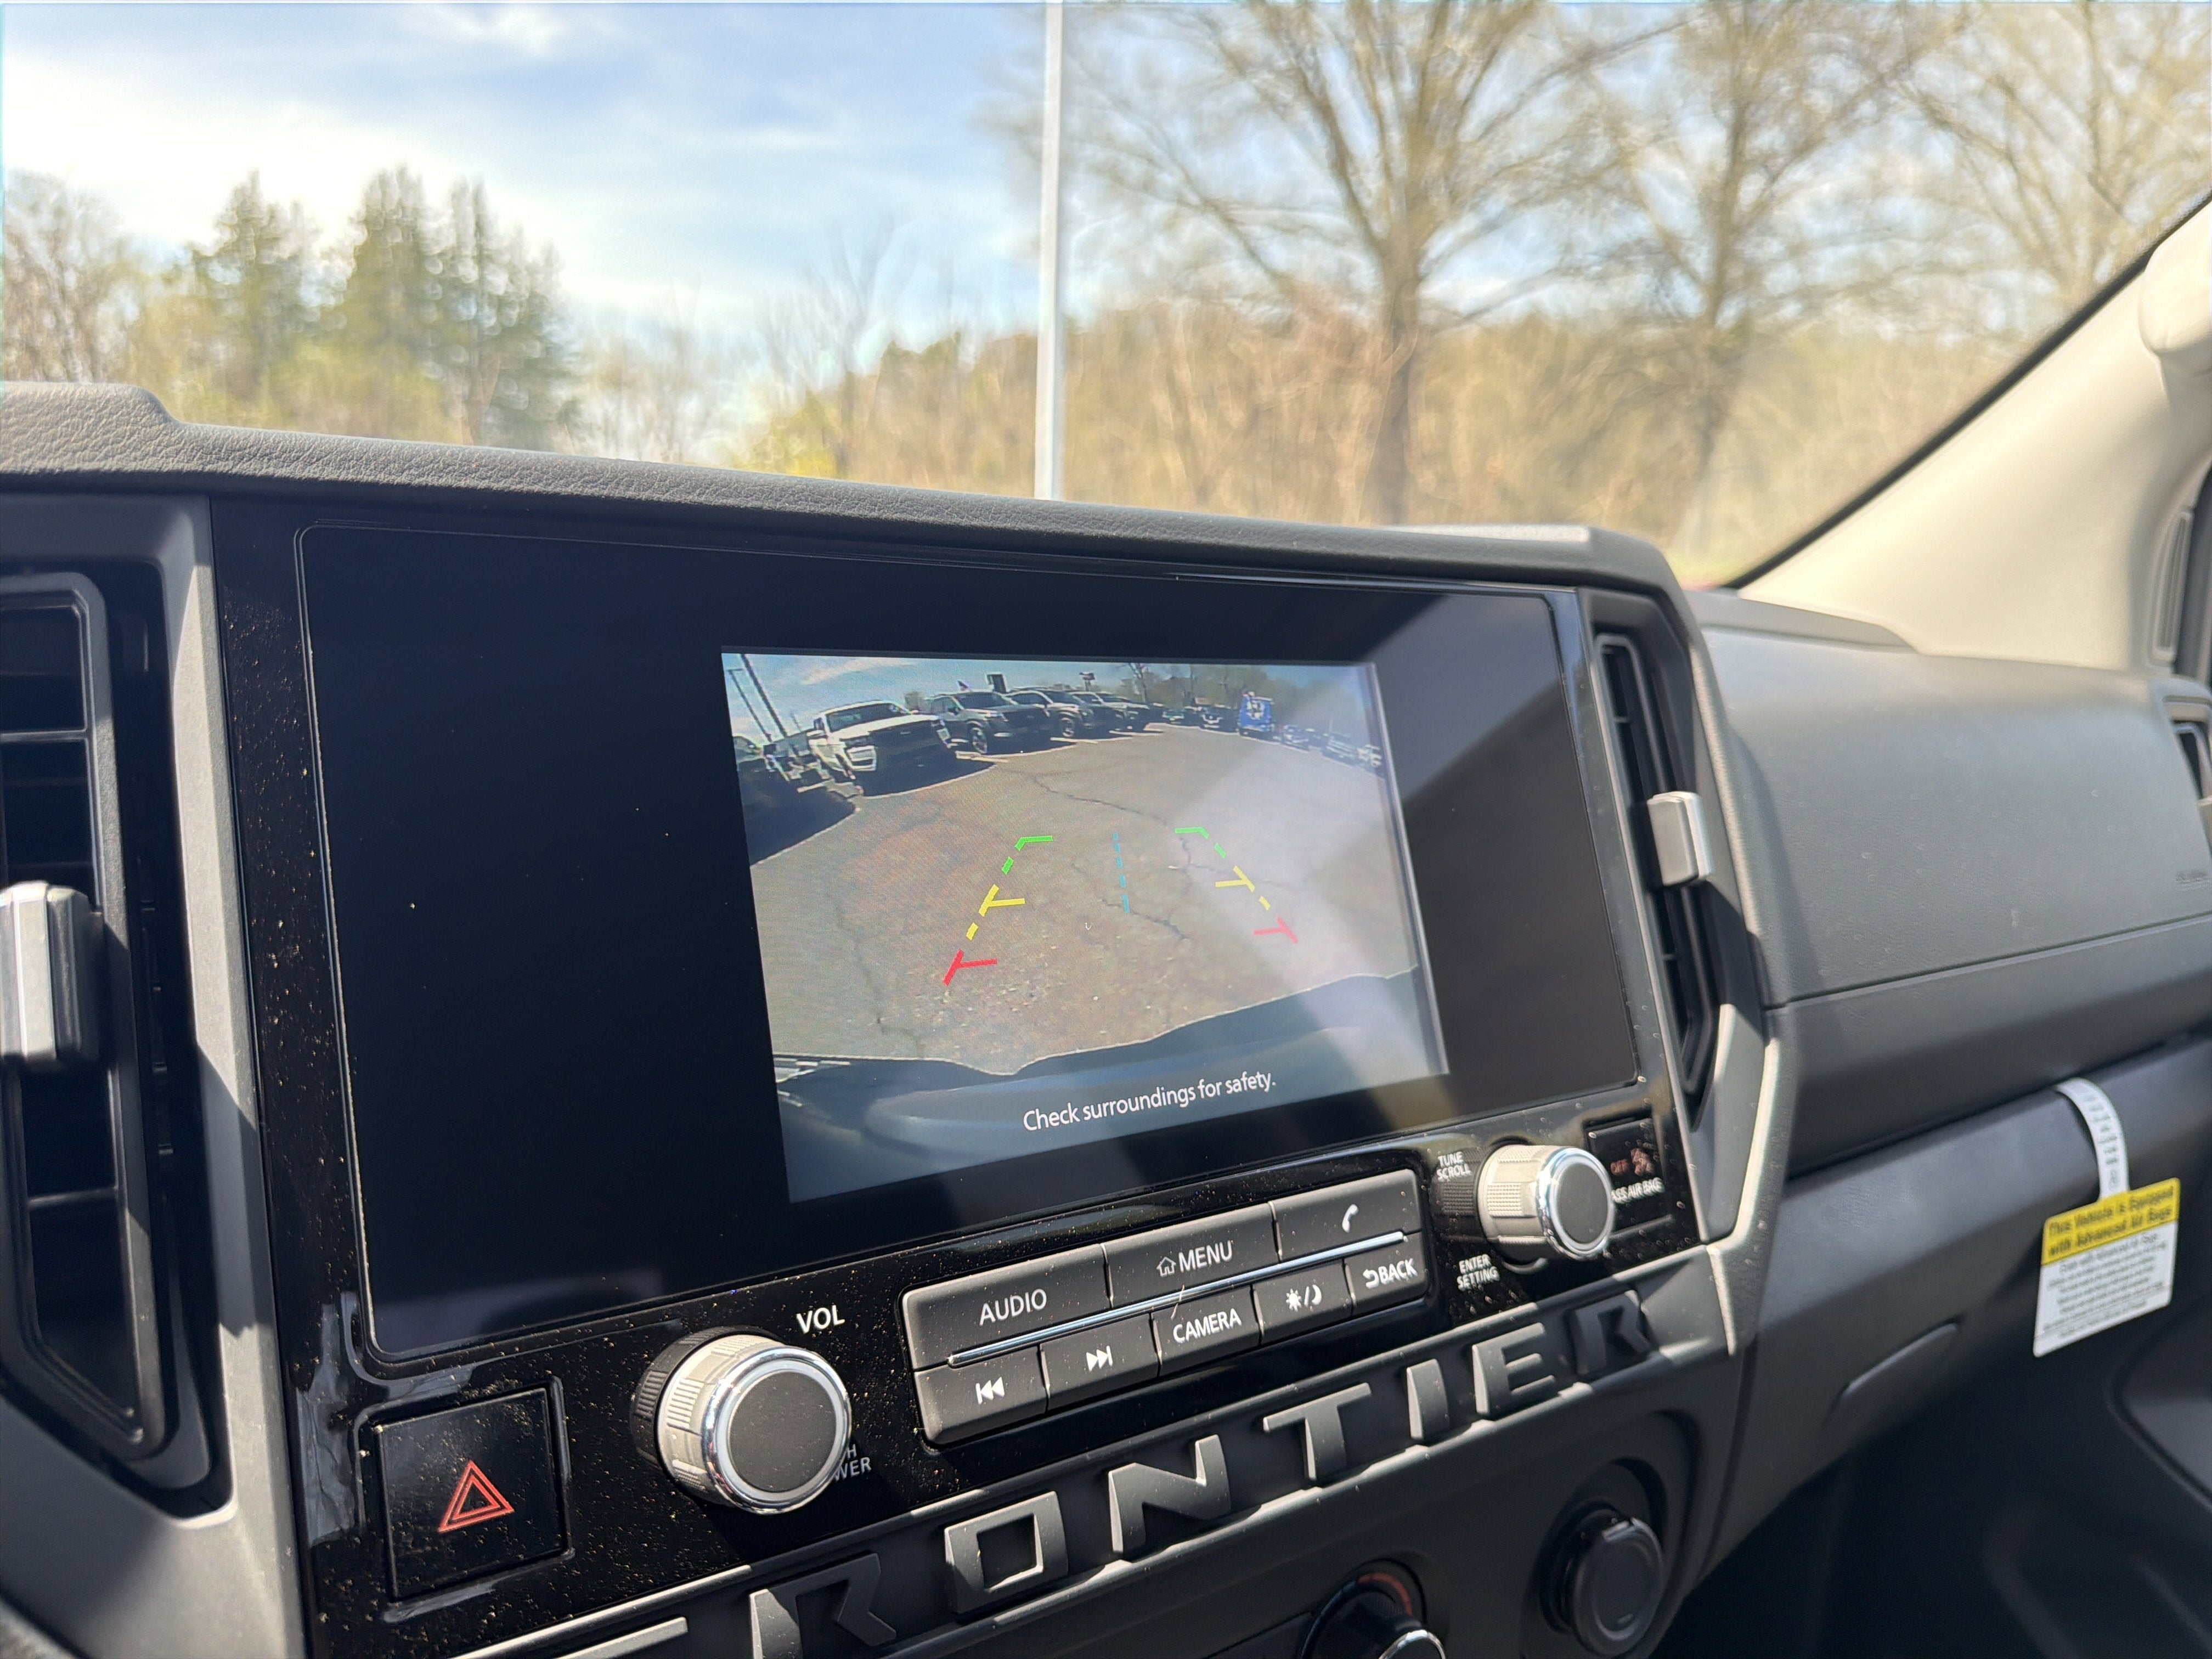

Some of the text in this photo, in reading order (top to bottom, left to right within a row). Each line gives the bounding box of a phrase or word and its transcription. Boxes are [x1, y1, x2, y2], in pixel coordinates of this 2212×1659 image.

[1023, 1071, 1277, 1131] Check surroundings for safety.
[1437, 1152, 1464, 1168] TUNE
[1437, 1163, 1471, 1181] SCROLL
[1611, 1186, 1630, 1204] ASS
[1178, 1240, 1233, 1273] MENU
[1459, 1254, 1492, 1274] ENTER
[1378, 1258, 1417, 1285] BACK
[1457, 1266, 1500, 1291] SETTING
[796, 1305, 845, 1333] VOL
[979, 1289, 1047, 1325] AUDIO
[1173, 1308, 1242, 1344] CAMERA
[833, 1457, 872, 1481] WER
